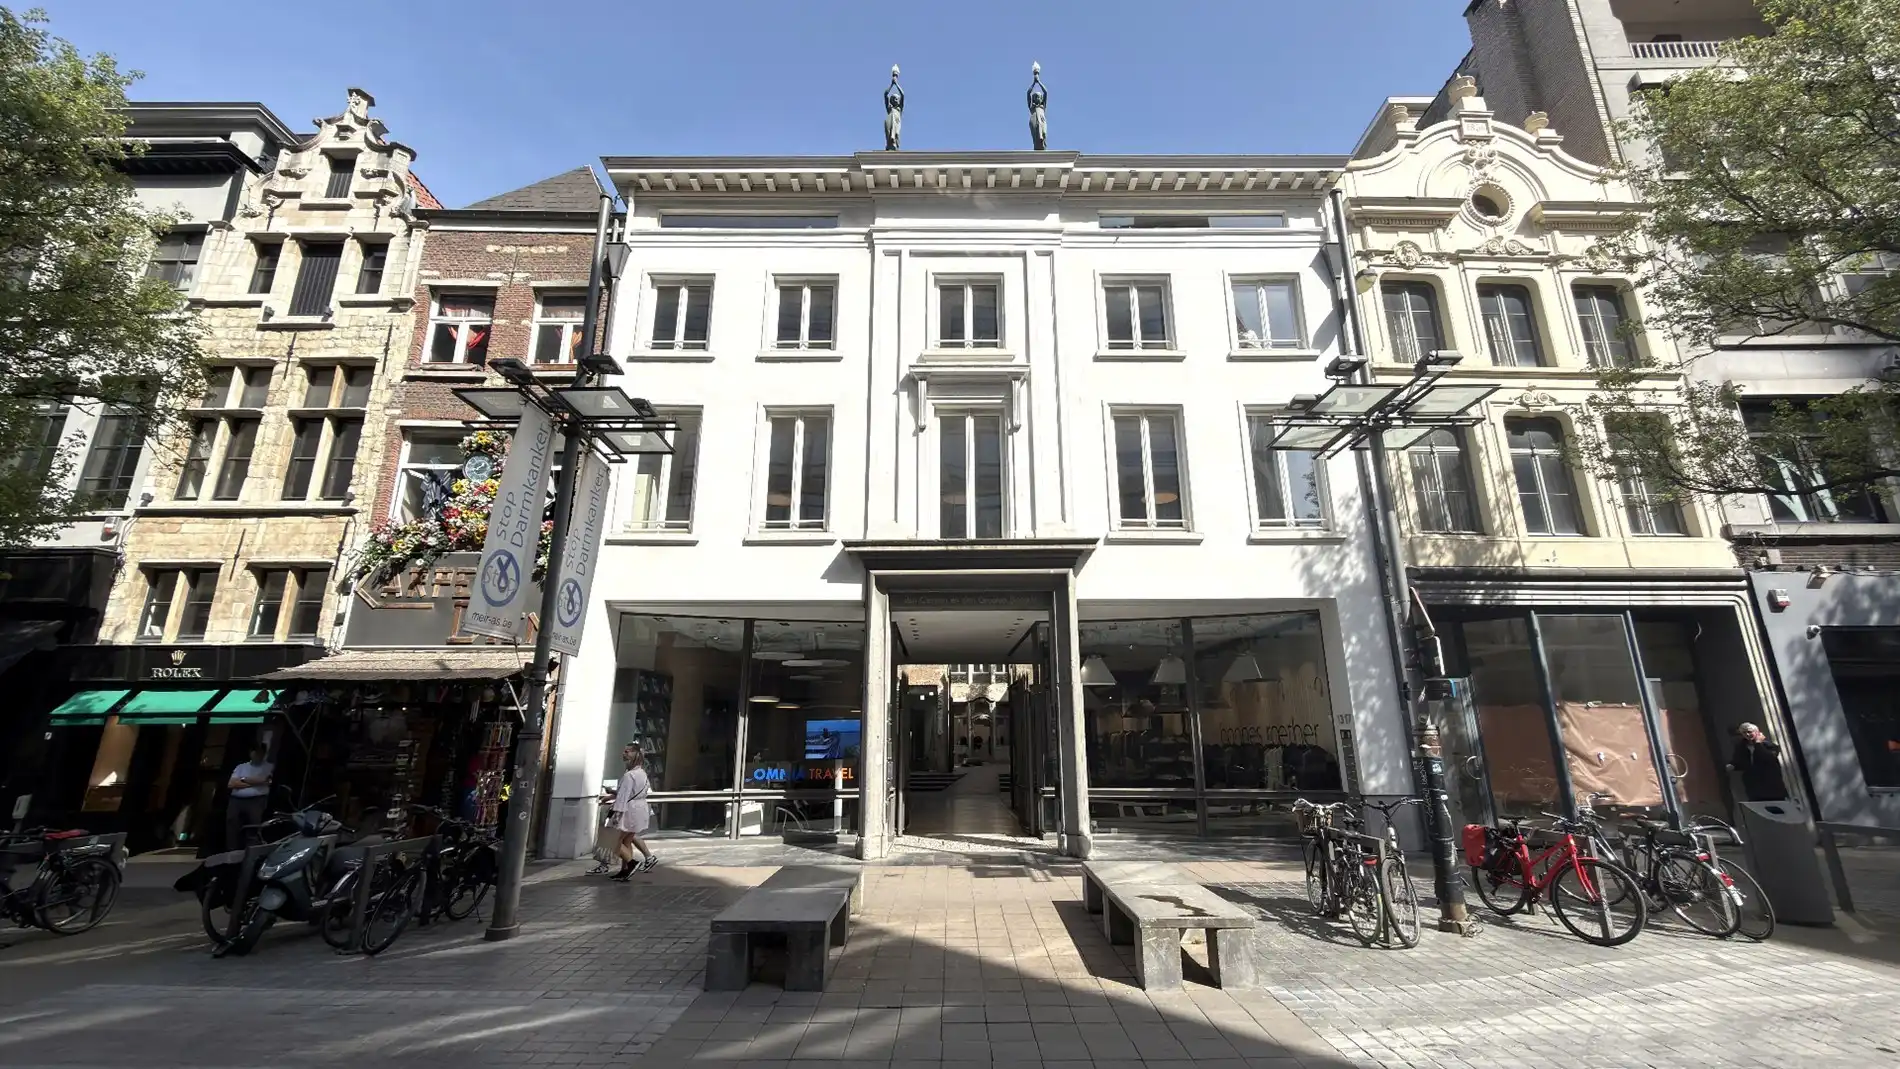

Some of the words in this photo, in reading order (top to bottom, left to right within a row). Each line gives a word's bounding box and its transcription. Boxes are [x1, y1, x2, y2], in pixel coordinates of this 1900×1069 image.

[510, 418, 551, 548] Darmkanker
[496, 491, 517, 541] Stop
[575, 467, 609, 576] Darmkanker
[565, 528, 581, 570] Stop
[471, 611, 513, 629] meir-as.be
[151, 667, 202, 678] ROLEX
[809, 767, 855, 780] TRAVEL
